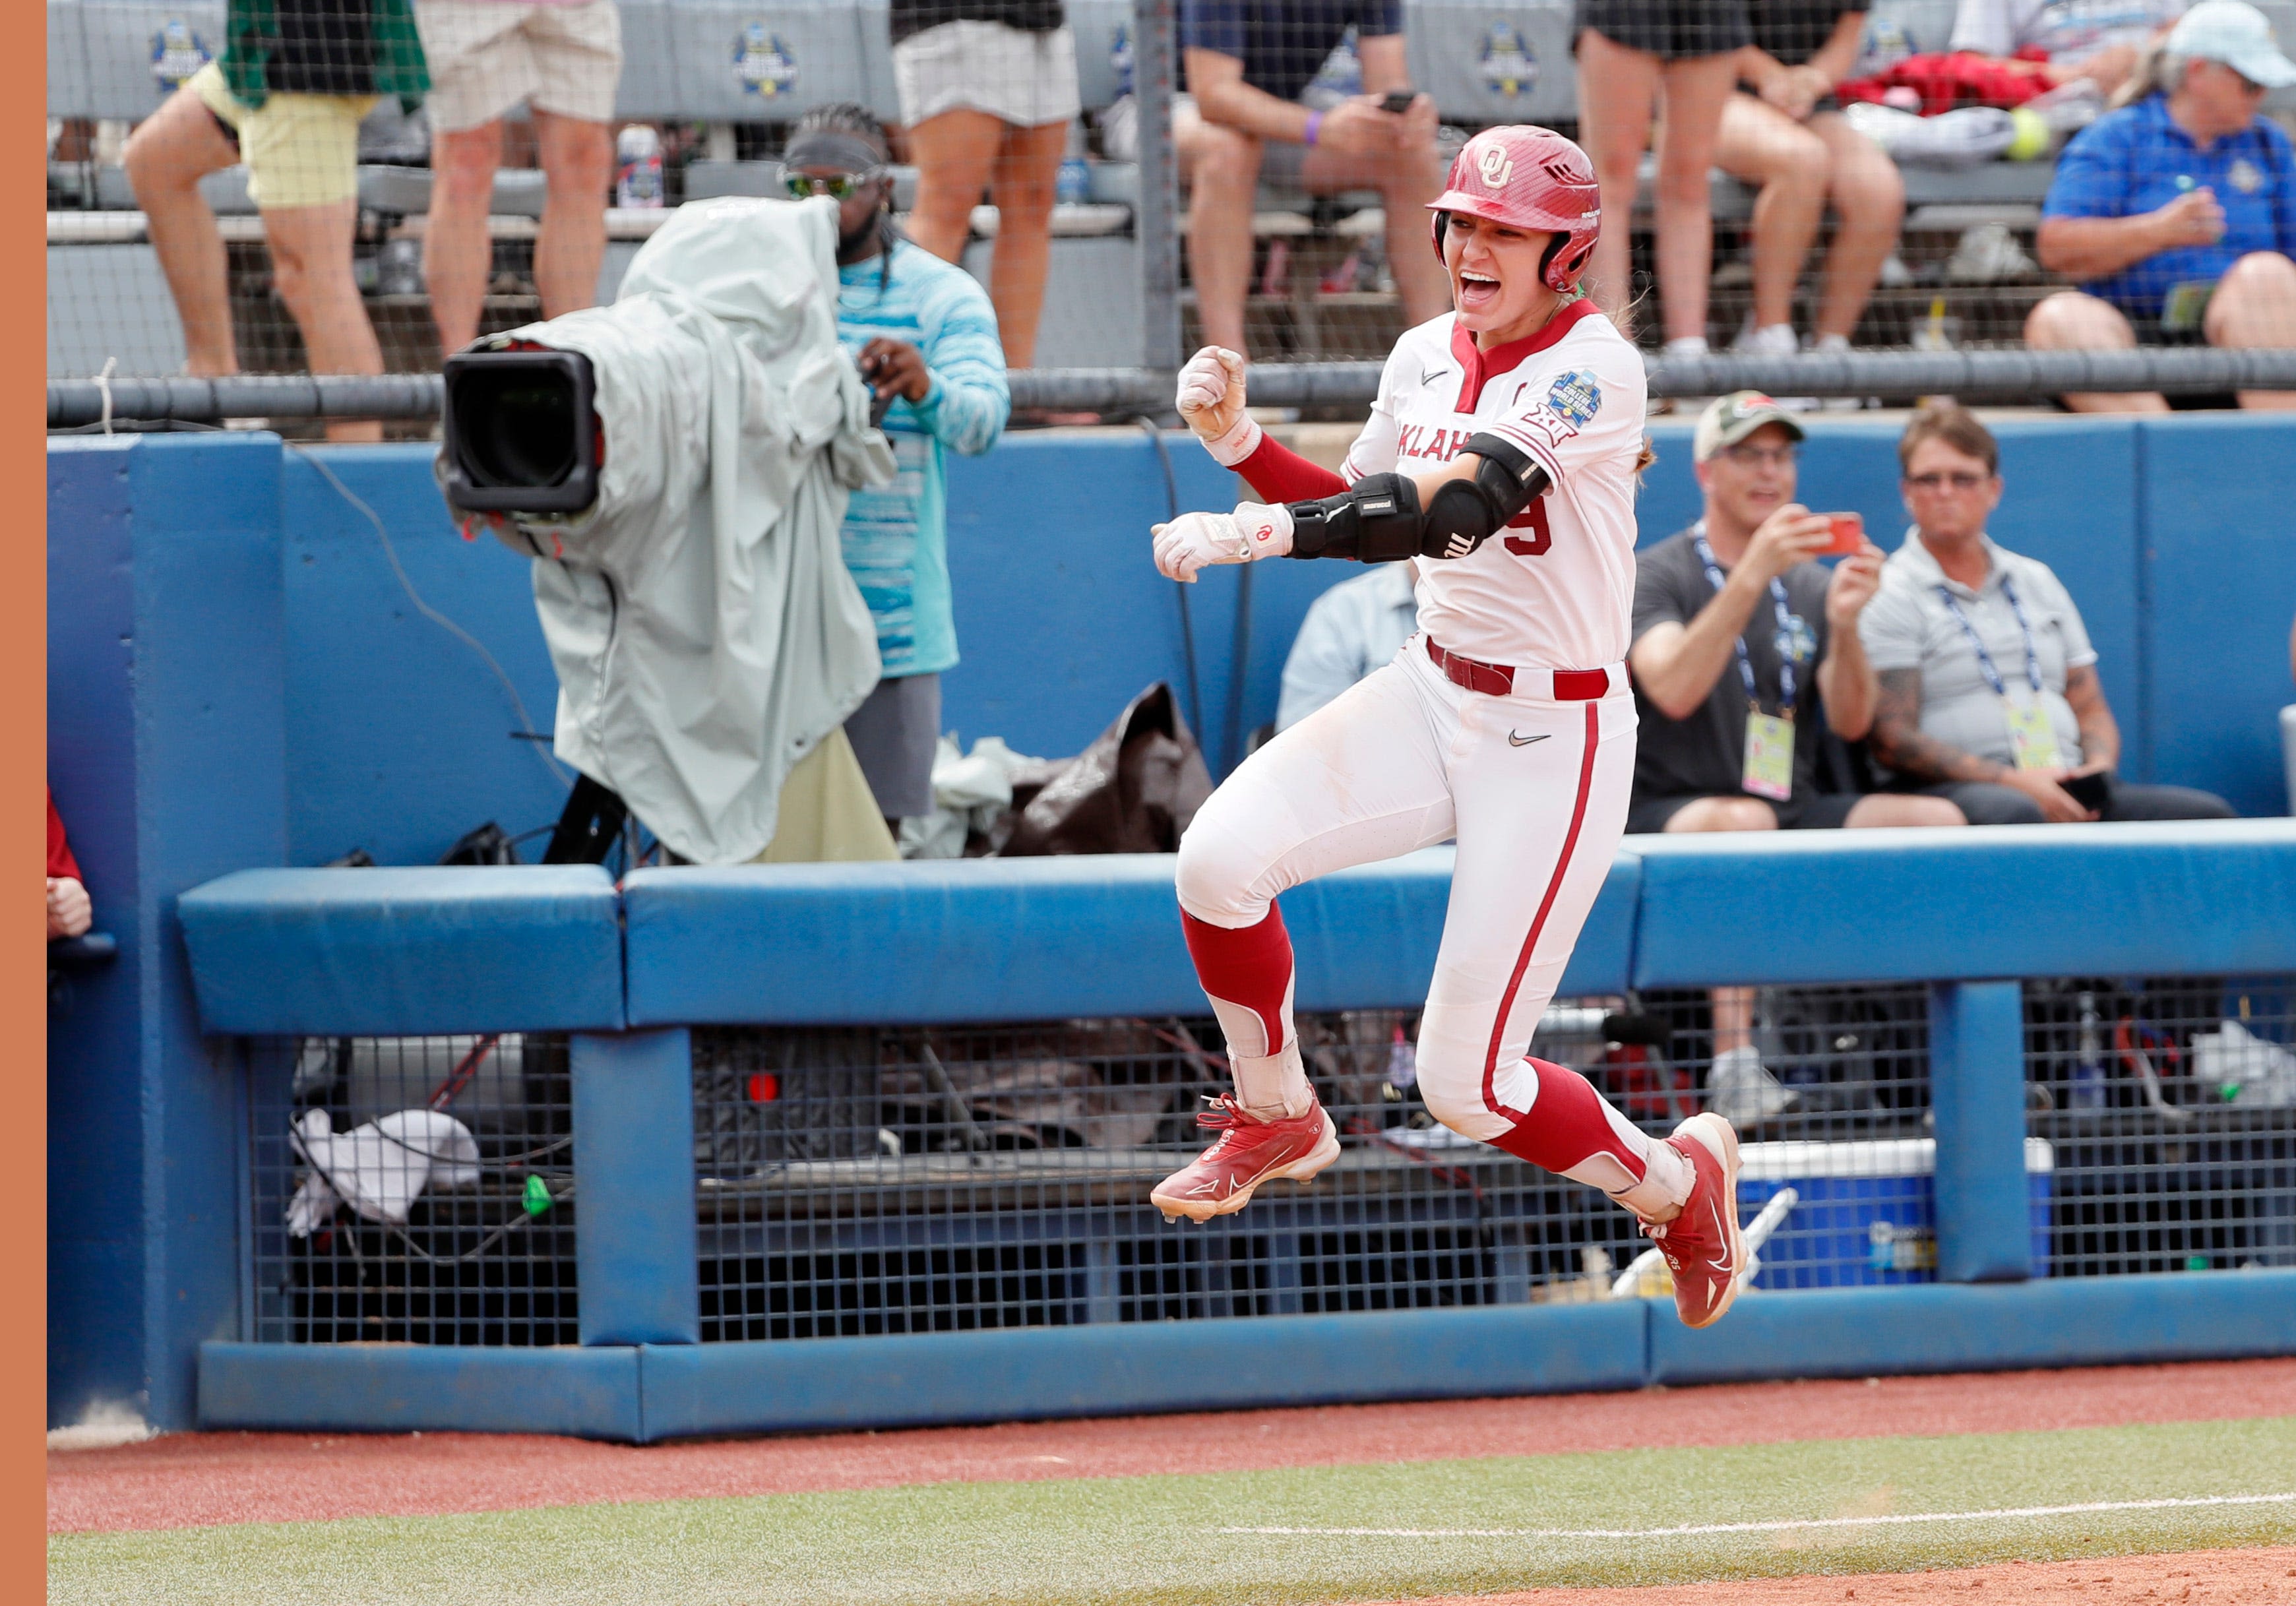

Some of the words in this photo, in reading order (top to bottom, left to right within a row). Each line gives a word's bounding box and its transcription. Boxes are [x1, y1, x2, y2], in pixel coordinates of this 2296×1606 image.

[1477, 144, 1514, 189] OU
[1550, 387, 1574, 404] WORLD
[1572, 400, 1594, 419] SERIES
[1563, 386, 1591, 407] COLLEGE
[1397, 423, 1472, 462] KLAH
[1504, 495, 1552, 556] 9
[1202, 1128, 1235, 1161] SOONERS
